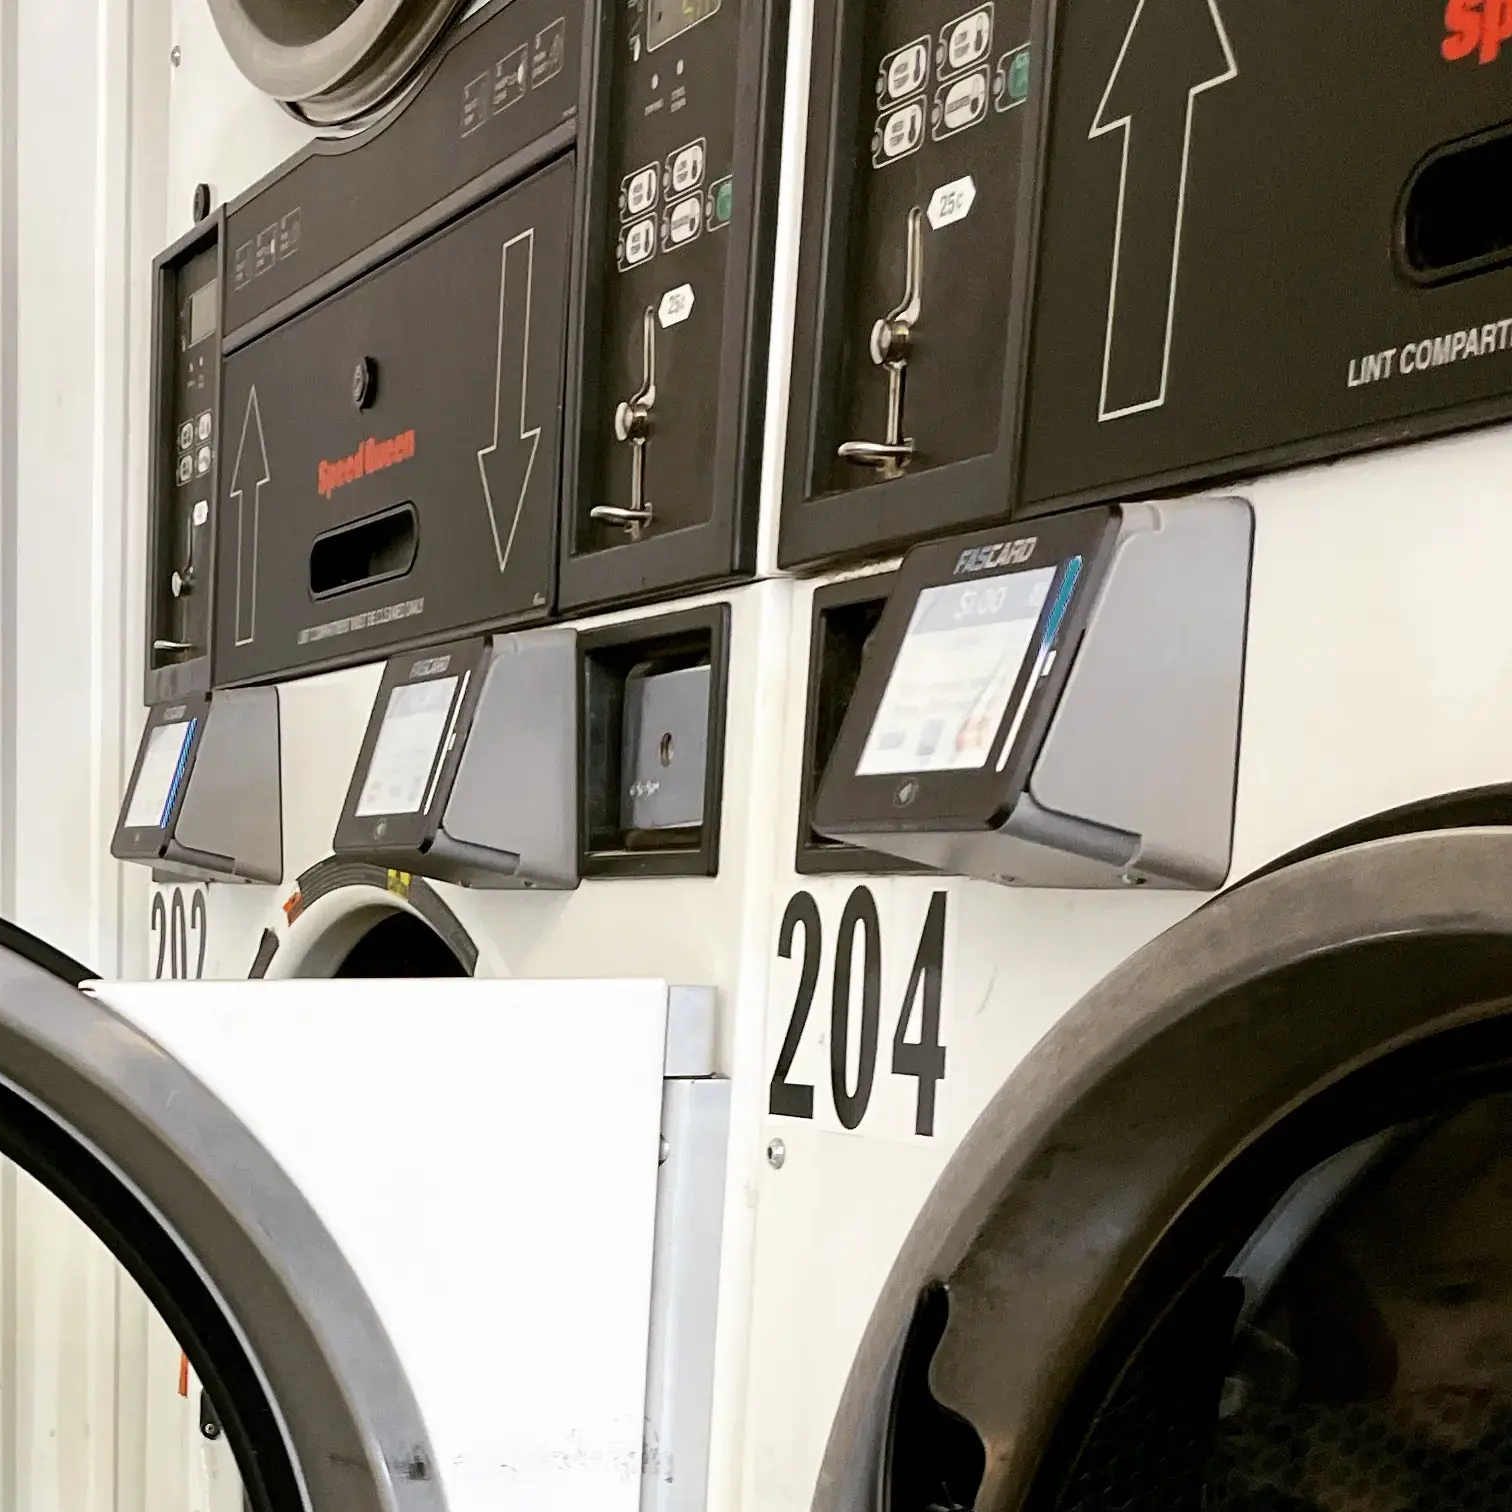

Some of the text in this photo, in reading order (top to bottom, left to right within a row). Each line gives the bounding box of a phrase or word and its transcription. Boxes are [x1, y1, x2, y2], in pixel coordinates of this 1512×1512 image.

[1347, 318, 1512, 388] LINT COMPART
[151, 886, 207, 980] 202
[768, 884, 949, 1138] 204
